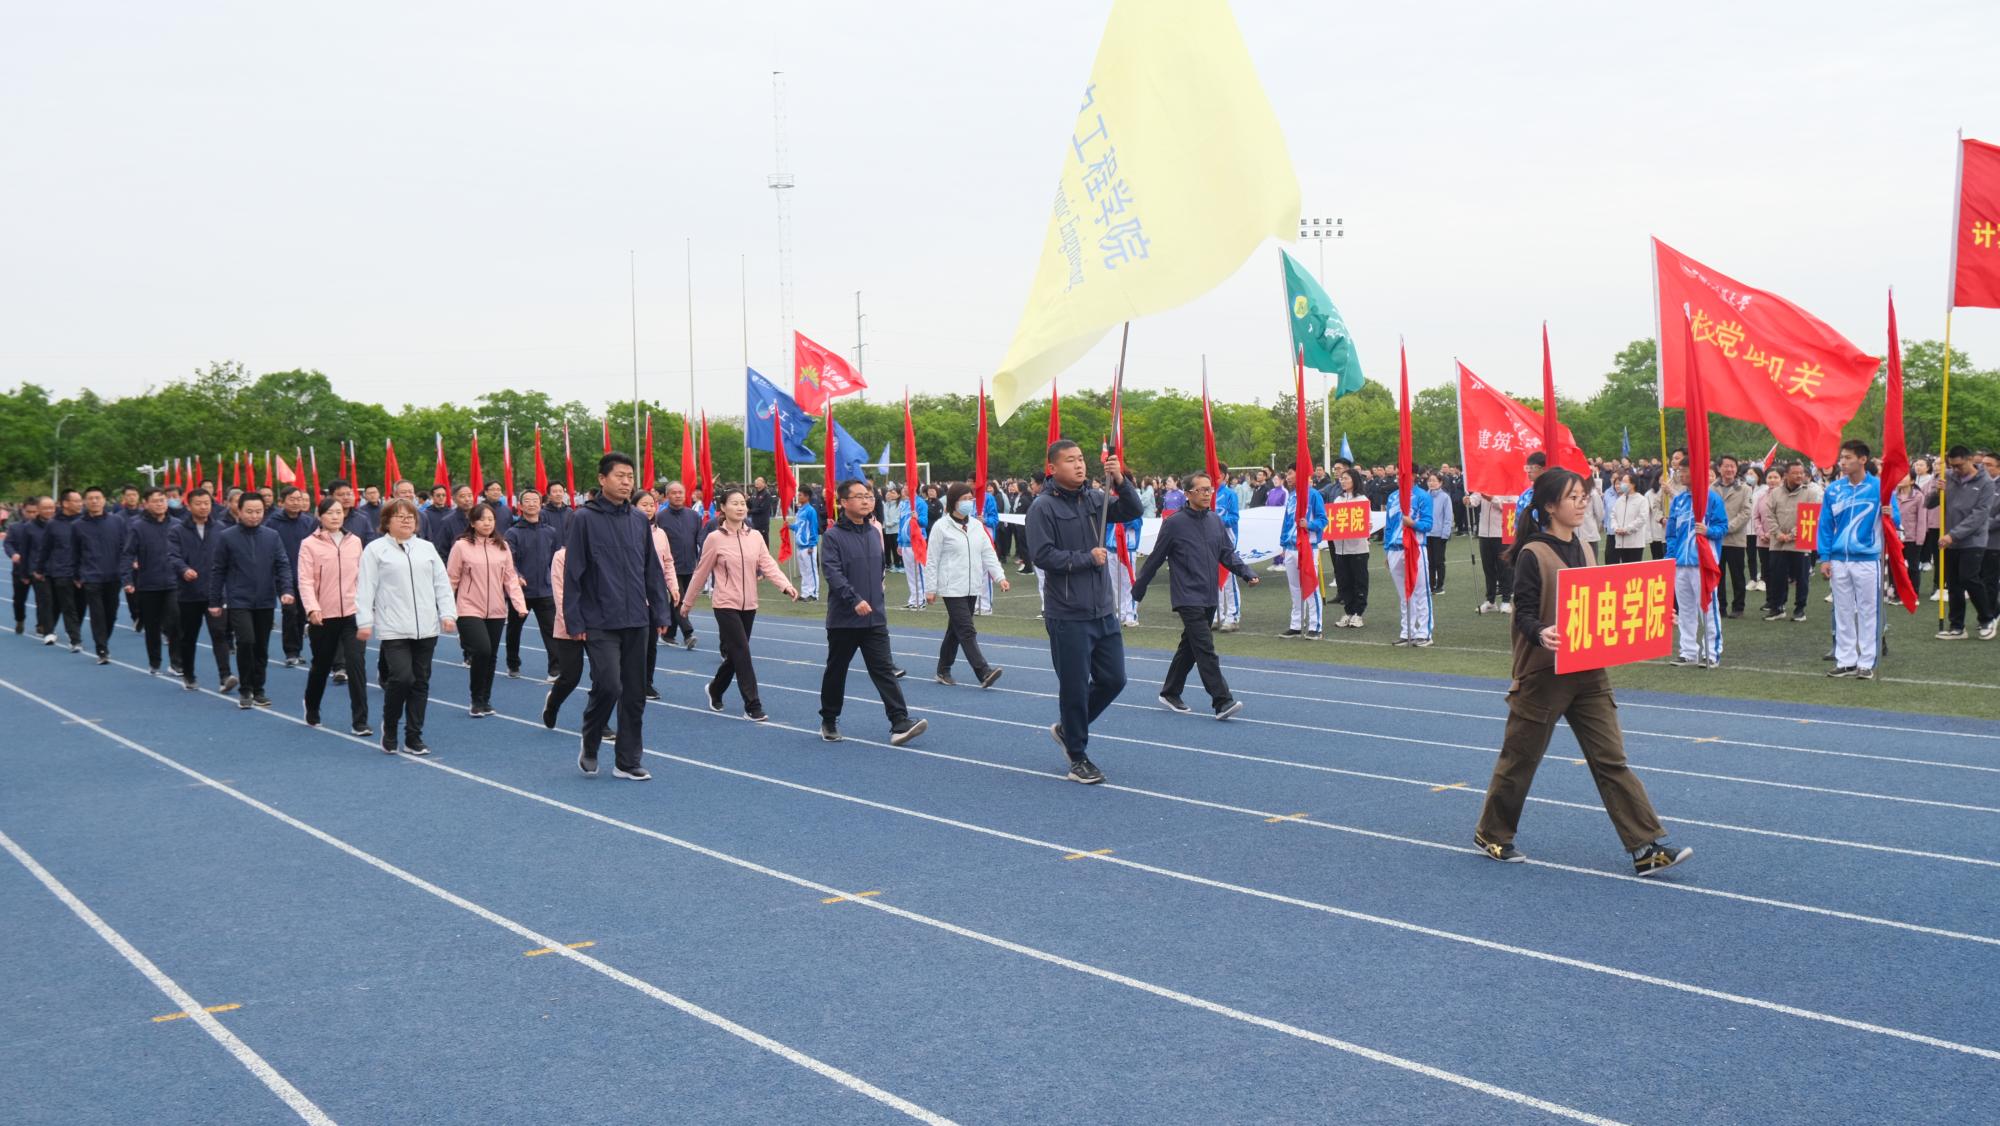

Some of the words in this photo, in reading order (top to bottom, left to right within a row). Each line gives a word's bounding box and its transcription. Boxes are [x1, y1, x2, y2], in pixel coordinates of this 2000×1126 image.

[1971, 220, 2000, 249] 计
[1478, 429, 1525, 454] 建筑
[1800, 509, 1817, 543] 计
[1566, 574, 1667, 653] 机电学院
